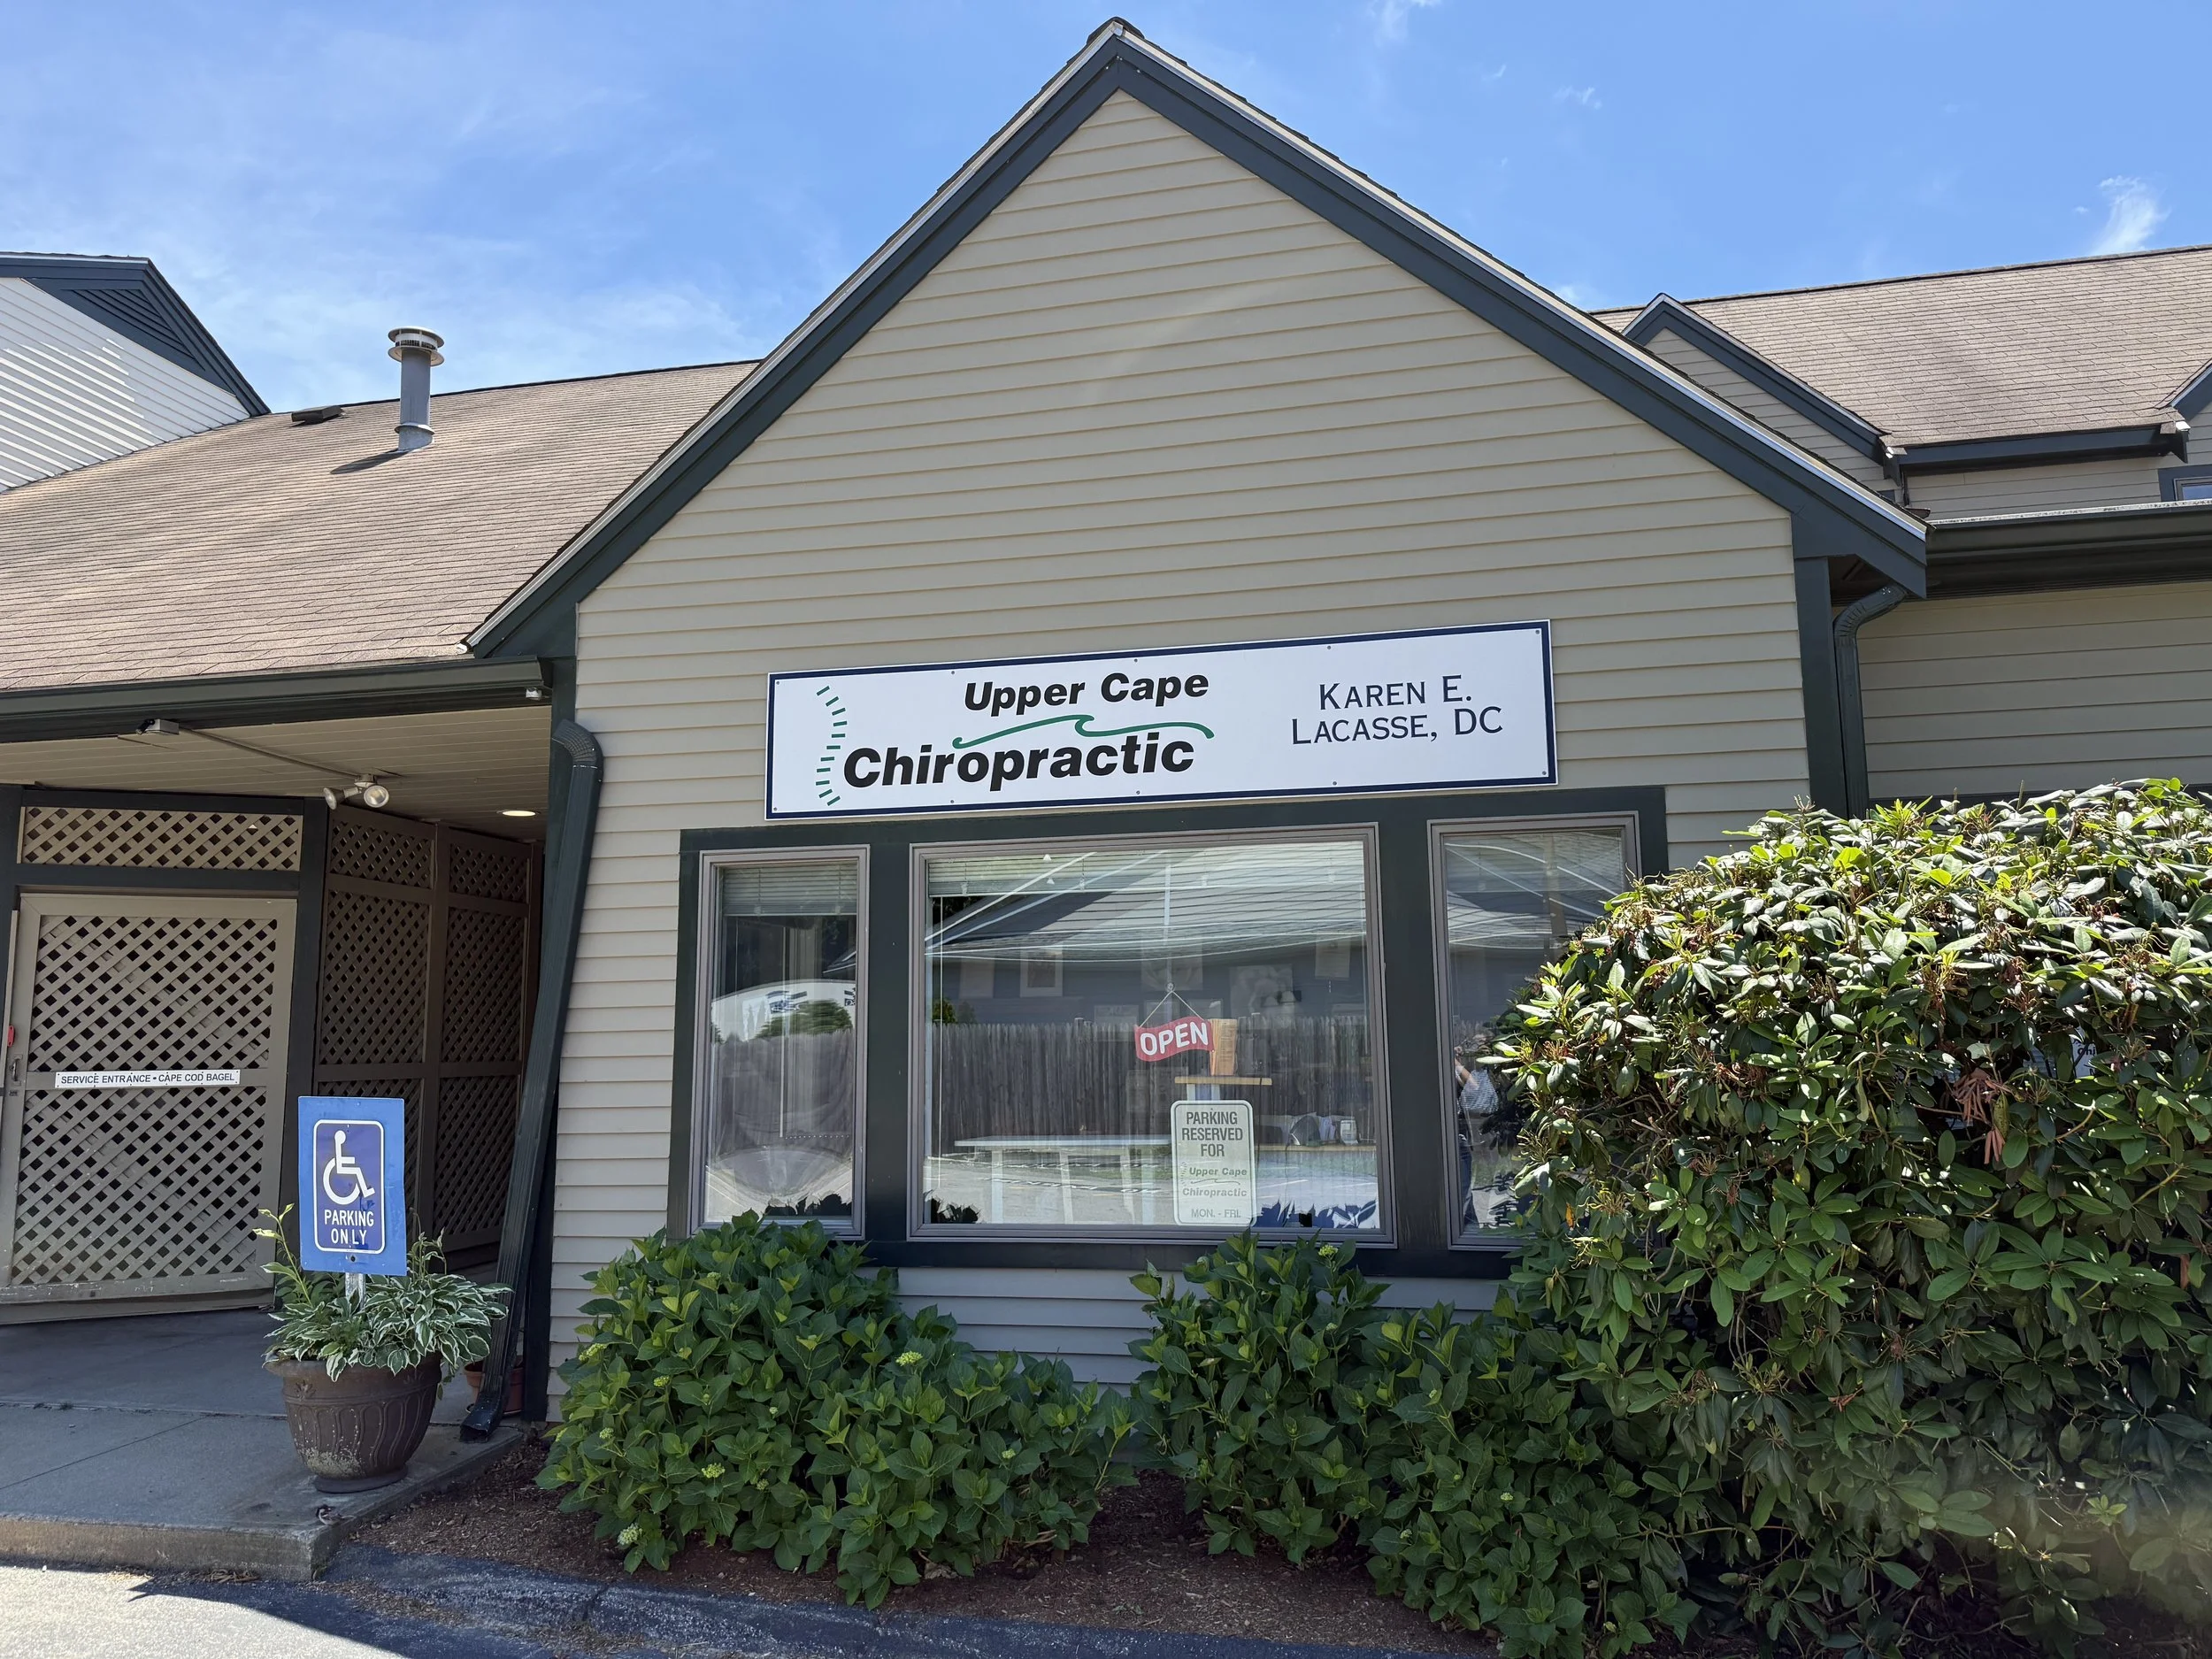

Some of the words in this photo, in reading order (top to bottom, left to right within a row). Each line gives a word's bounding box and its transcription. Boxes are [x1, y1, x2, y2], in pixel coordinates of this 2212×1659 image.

[964, 681, 1086, 718] Upper
[1101, 672, 1210, 707] Cape
[1319, 680, 1426, 710] KAREN
[1442, 674, 1472, 703] E.
[1292, 714, 1438, 745] LACASSE,
[1454, 705, 1503, 735] DC
[843, 732, 1194, 792] Chiropractic
[1140, 1021, 1209, 1056] OPEN
[61, 1075, 99, 1084] SERVICE
[102, 1074, 151, 1083] ENTRANCE
[158, 1073, 182, 1082] CAPE
[184, 1073, 204, 1082] COD
[206, 1072, 234, 1081] BAGEL
[1186, 1111, 1238, 1125] PARKING
[1182, 1127, 1243, 1141] RESERVED
[1201, 1143, 1225, 1157] FOR
[1189, 1167, 1218, 1177] Upper
[1222, 1167, 1248, 1178] Cape
[1182, 1187, 1248, 1198] Chiropractic
[324, 1209, 375, 1227] PARKING
[1191, 1209, 1216, 1218] MON.
[330, 1227, 368, 1245] ONLY
